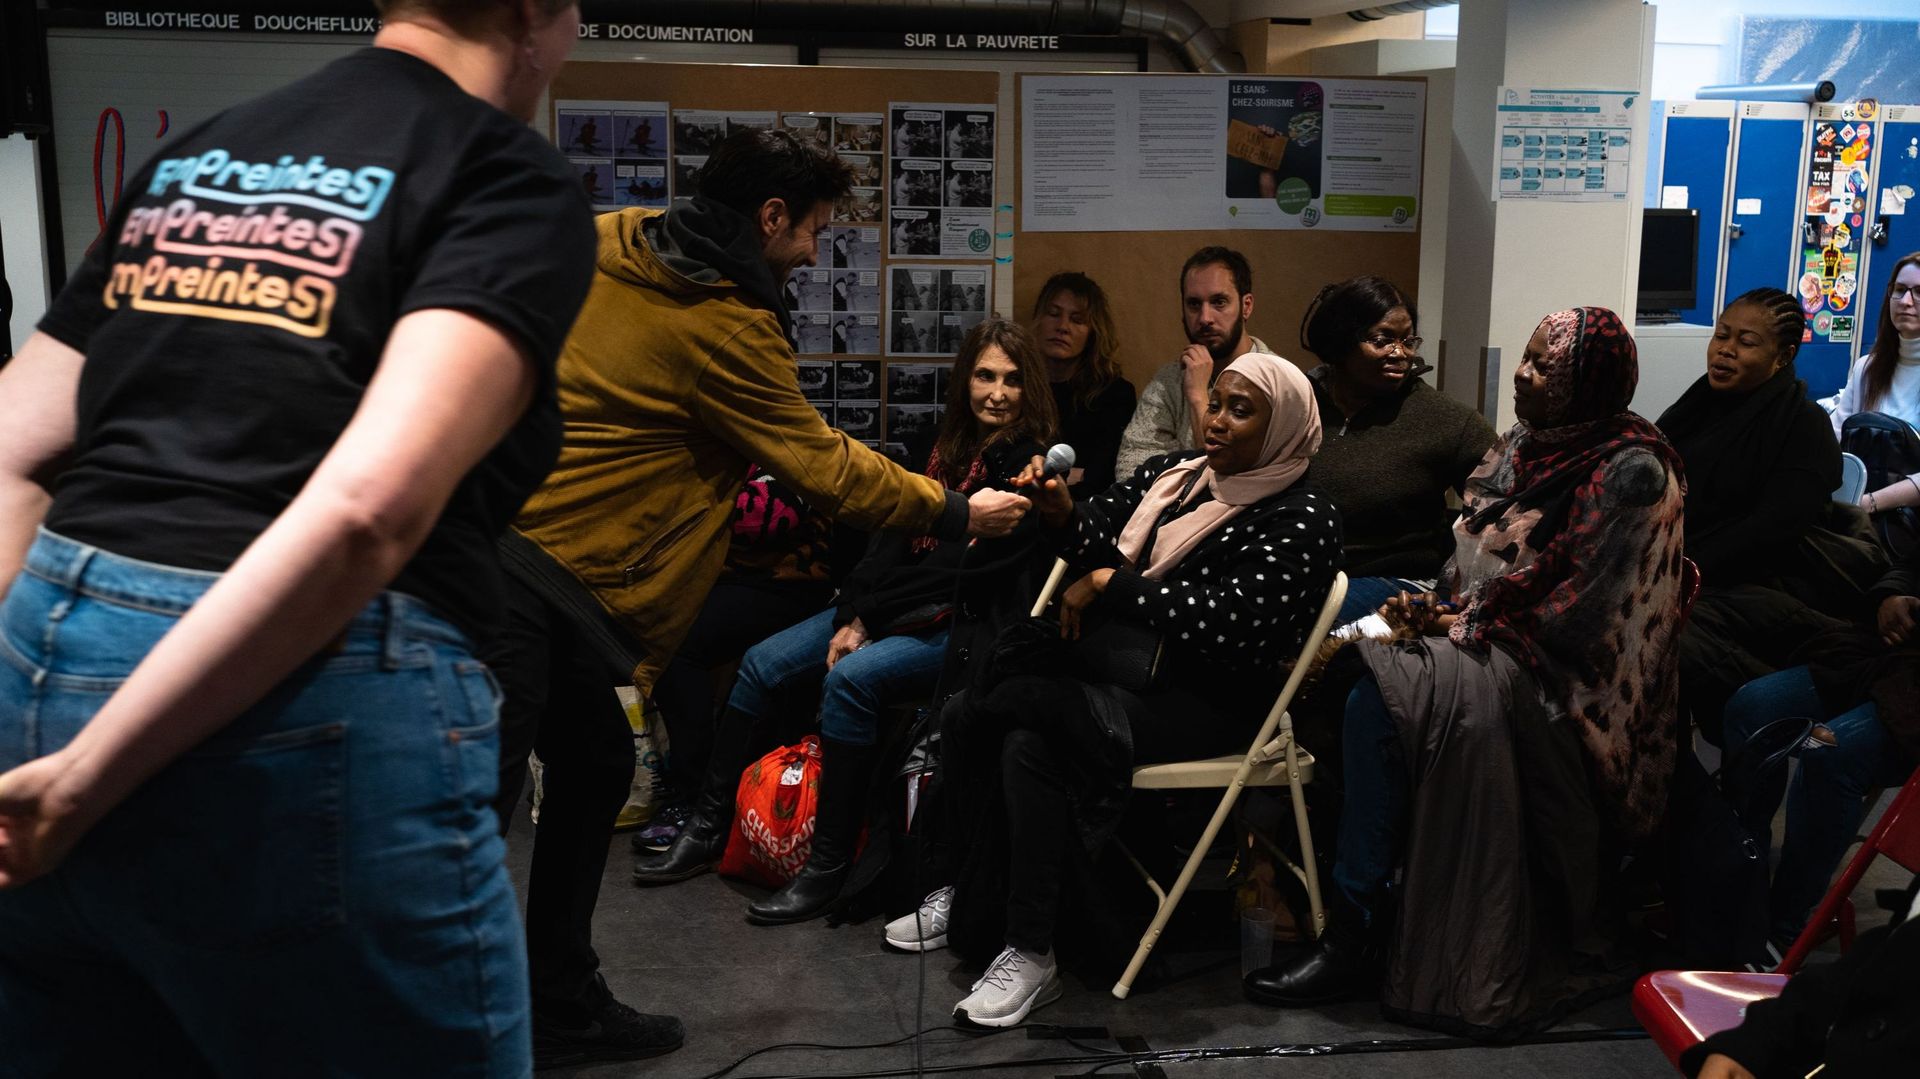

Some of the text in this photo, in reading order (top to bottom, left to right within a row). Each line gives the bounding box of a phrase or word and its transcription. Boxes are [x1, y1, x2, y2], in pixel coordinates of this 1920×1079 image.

[105, 11, 240, 29] BIBLIOTHEQUE
[577, 23, 753, 43] DE DOCUMENTATION
[904, 33, 1059, 49] SUR LA PAUVRETE
[1232, 85, 1242, 94] LE
[1232, 98, 1295, 108] CHEZ-SOIRISME
[1812, 171, 1831, 181] TAX
